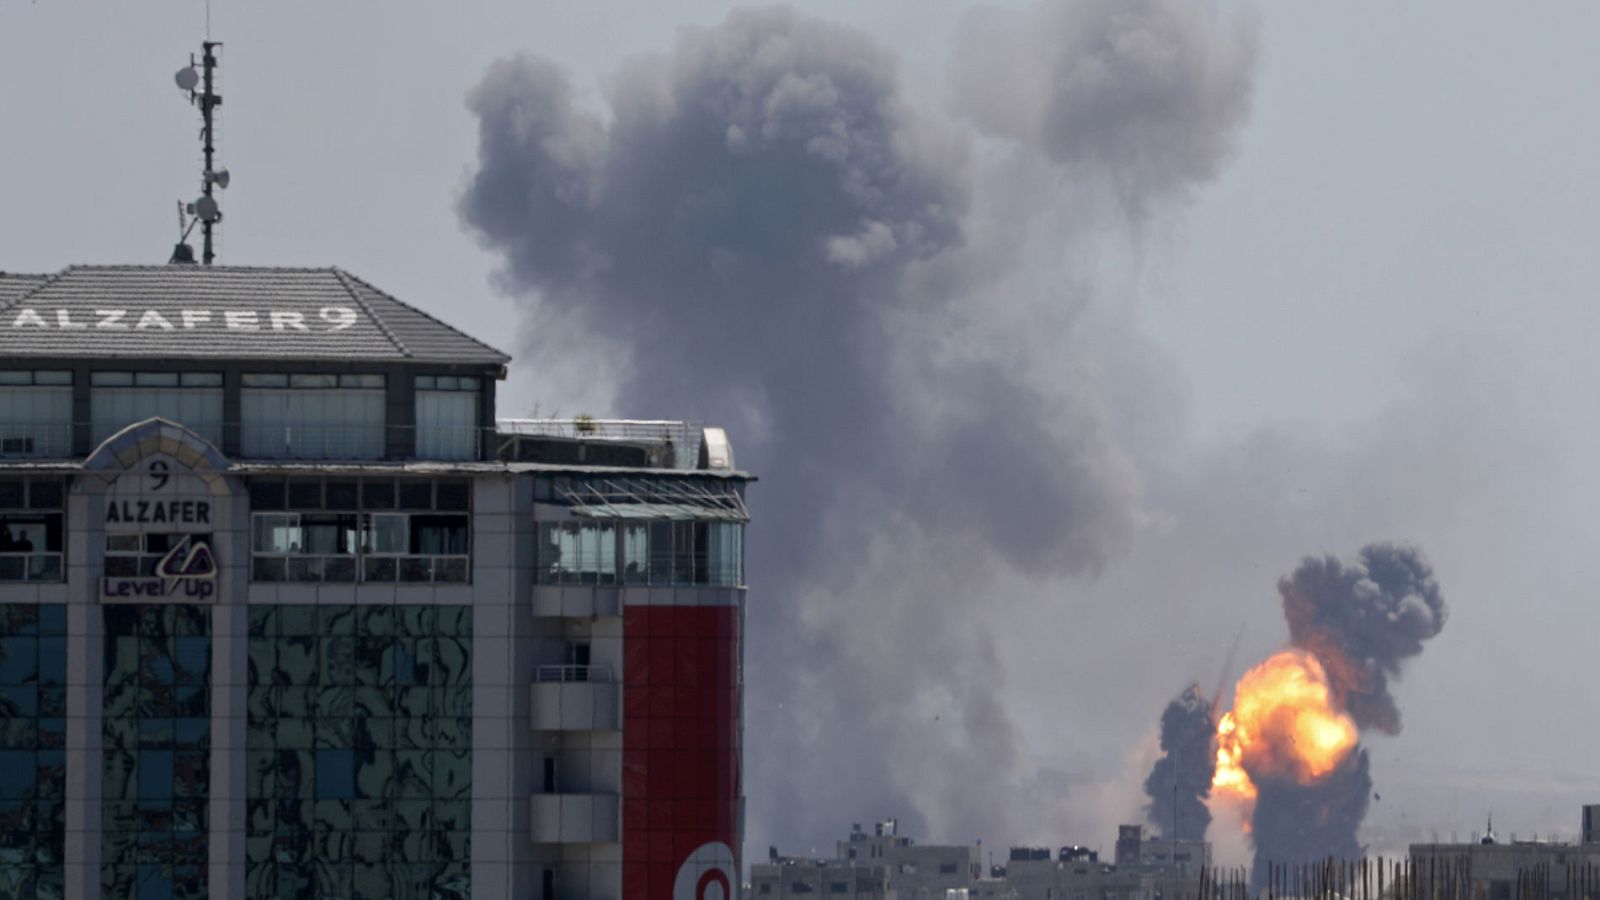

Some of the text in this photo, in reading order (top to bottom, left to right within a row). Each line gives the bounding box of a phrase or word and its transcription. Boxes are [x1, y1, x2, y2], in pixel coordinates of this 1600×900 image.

[149, 460, 170, 491] 9
[106, 501, 210, 524] ALZAFER
[104, 578, 214, 599] Level Up
